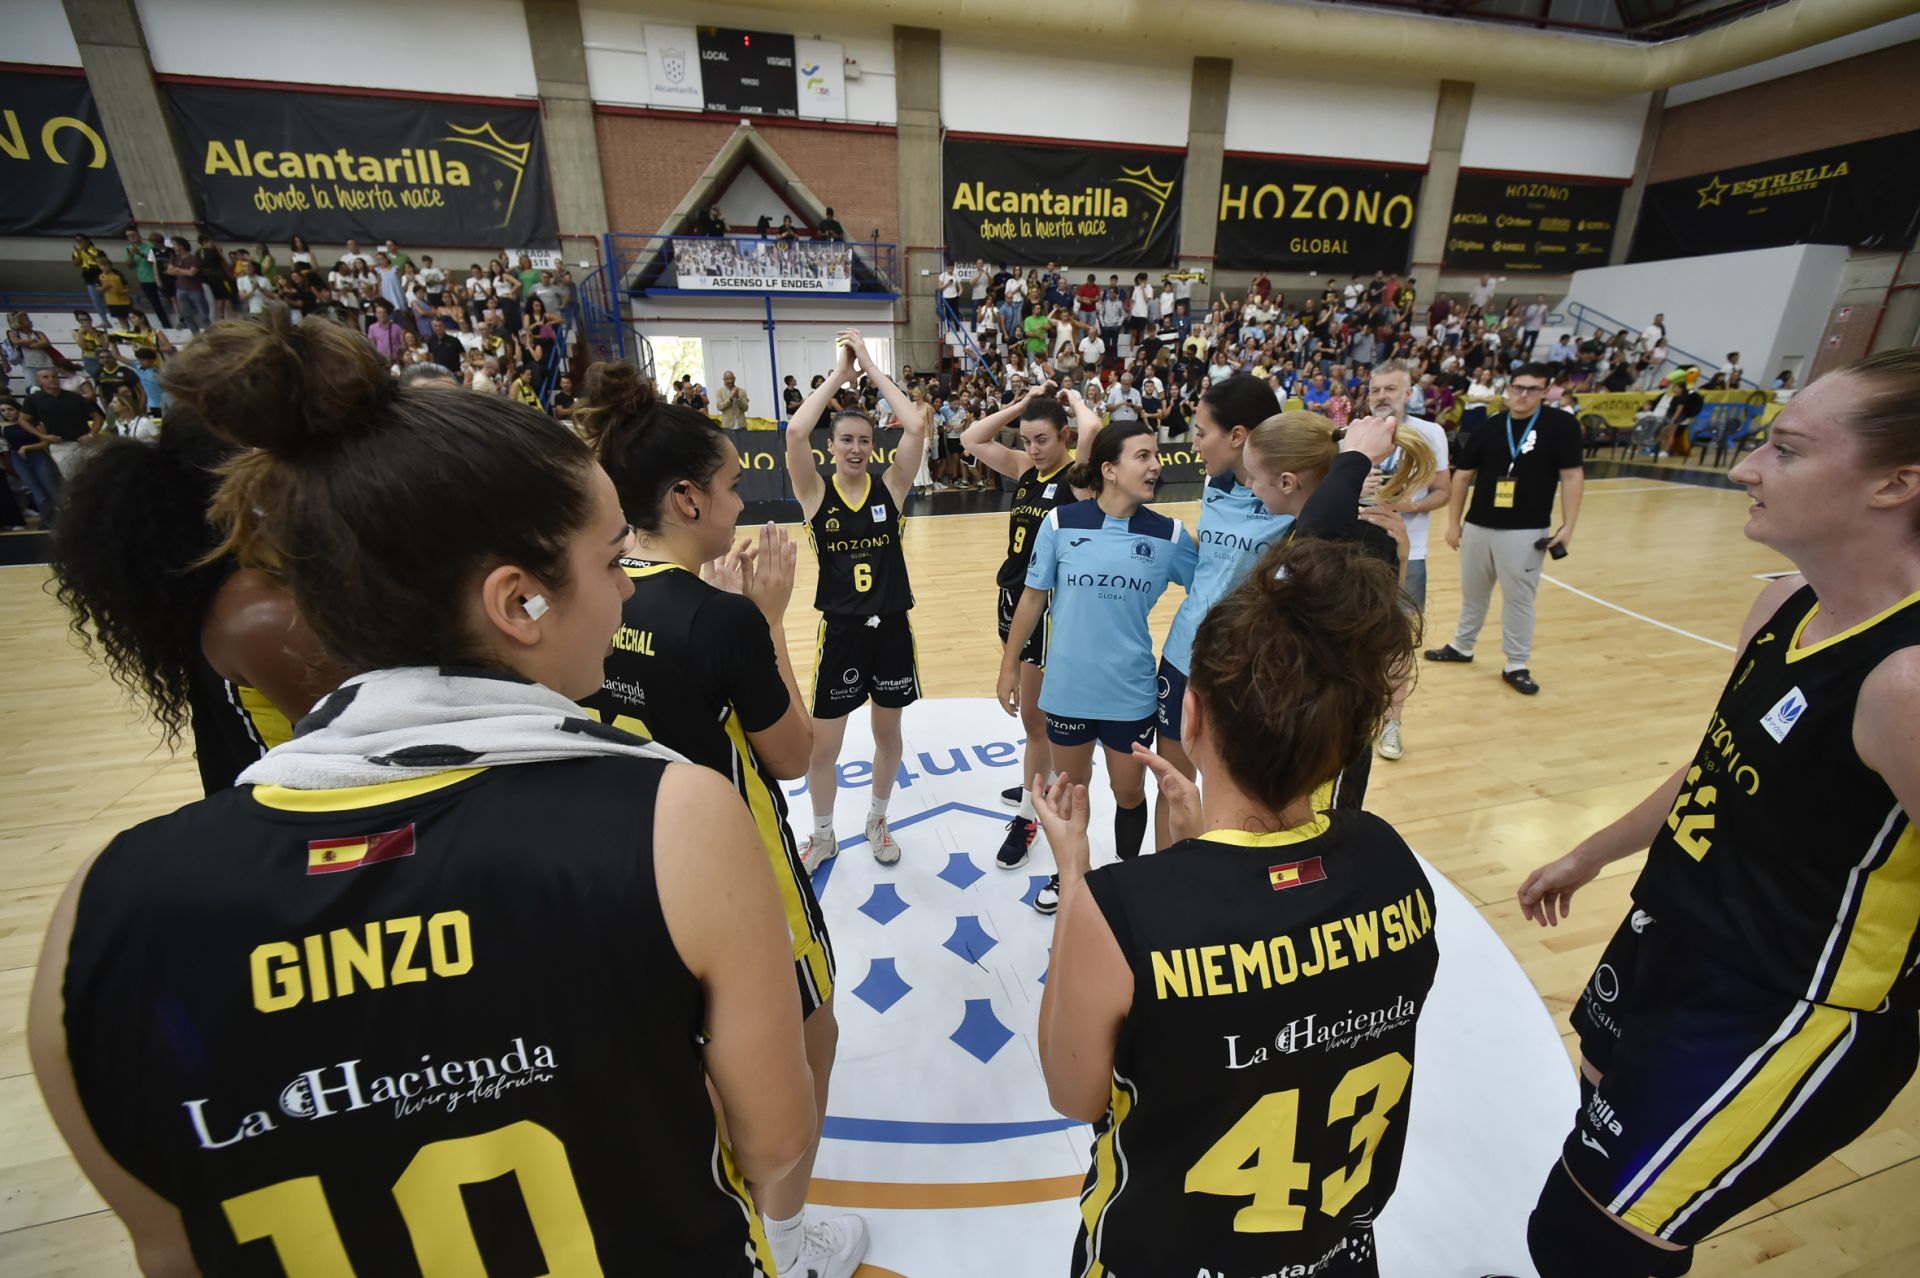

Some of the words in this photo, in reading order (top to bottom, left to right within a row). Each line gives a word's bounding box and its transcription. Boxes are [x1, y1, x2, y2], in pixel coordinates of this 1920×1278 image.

[702, 50, 729, 61] LOCAL
[654, 84, 698, 95] Alcantarilla
[205, 139, 471, 187] Alcantarilla
[1505, 184, 1569, 201] HOZONO
[1730, 160, 1849, 196] ESTRELLA
[1768, 181, 1819, 196] LEVANTE
[254, 183, 310, 213] donde
[311, 184, 334, 209] la
[334, 183, 398, 212] huerta
[400, 186, 445, 209] nace
[952, 181, 1128, 218] Alcantarilla
[1220, 183, 1413, 229] HOZONO
[980, 217, 1017, 240] donde
[1020, 216, 1032, 238] la
[1035, 216, 1075, 239] huerta
[1078, 219, 1107, 236] nace
[1290, 237, 1349, 254] GLOBAL
[712, 278, 763, 287] ASCENSO
[766, 278, 778, 287] LF
[781, 279, 823, 289] ENDESA
[826, 533, 890, 552] HOZONO
[1013, 526, 1026, 554] 9
[853, 563, 872, 593] 6
[1067, 573, 1152, 594] HOZONO
[1097, 592, 1127, 601] GLOBAL
[601, 676, 645, 699] acienda
[1151, 888, 1431, 1000] NIEMOJEWSKA
[250, 910, 473, 1013] GINZO
[1223, 1035, 1269, 1069] La
[1286, 995, 1415, 1054] Hacienda
[182, 1098, 278, 1149] La
[304, 1038, 558, 1119] Hacienda
[465, 1067, 554, 1104] disfrutar
[1184, 1051, 1412, 1234] 43
